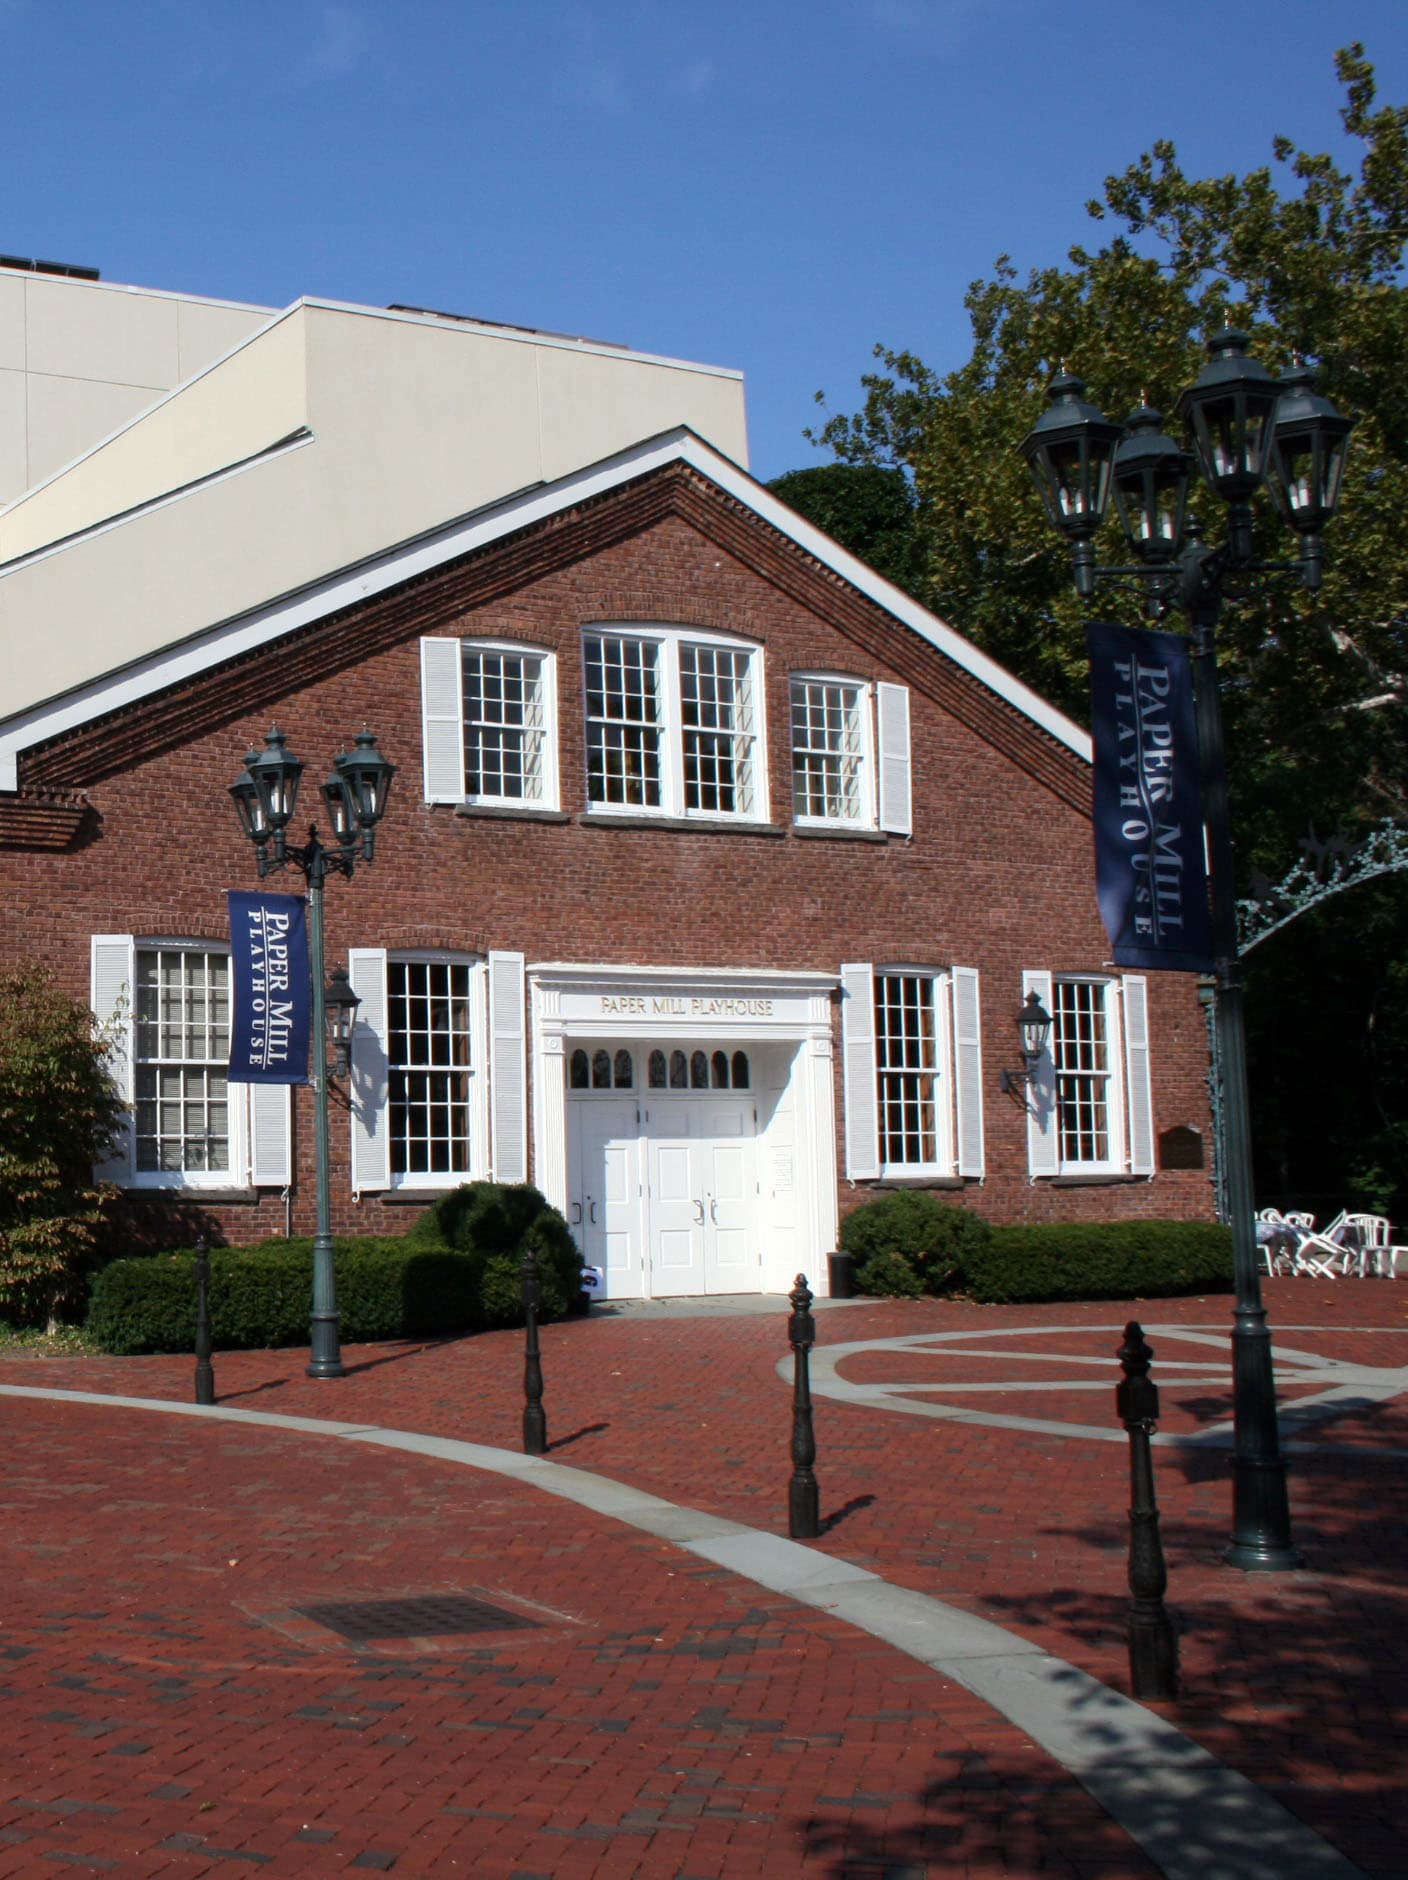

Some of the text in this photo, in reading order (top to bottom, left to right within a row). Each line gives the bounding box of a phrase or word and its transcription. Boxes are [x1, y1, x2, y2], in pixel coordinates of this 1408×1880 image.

[1114, 662, 1152, 934] PLAYHOUSE
[1137, 662, 1184, 936] PAPER MILL
[247, 910, 265, 1065] PLAYHOUSE
[265, 910, 293, 1065] PAPER MILL
[601, 997, 774, 1016] PAPER MILL PLAYHOUSE
